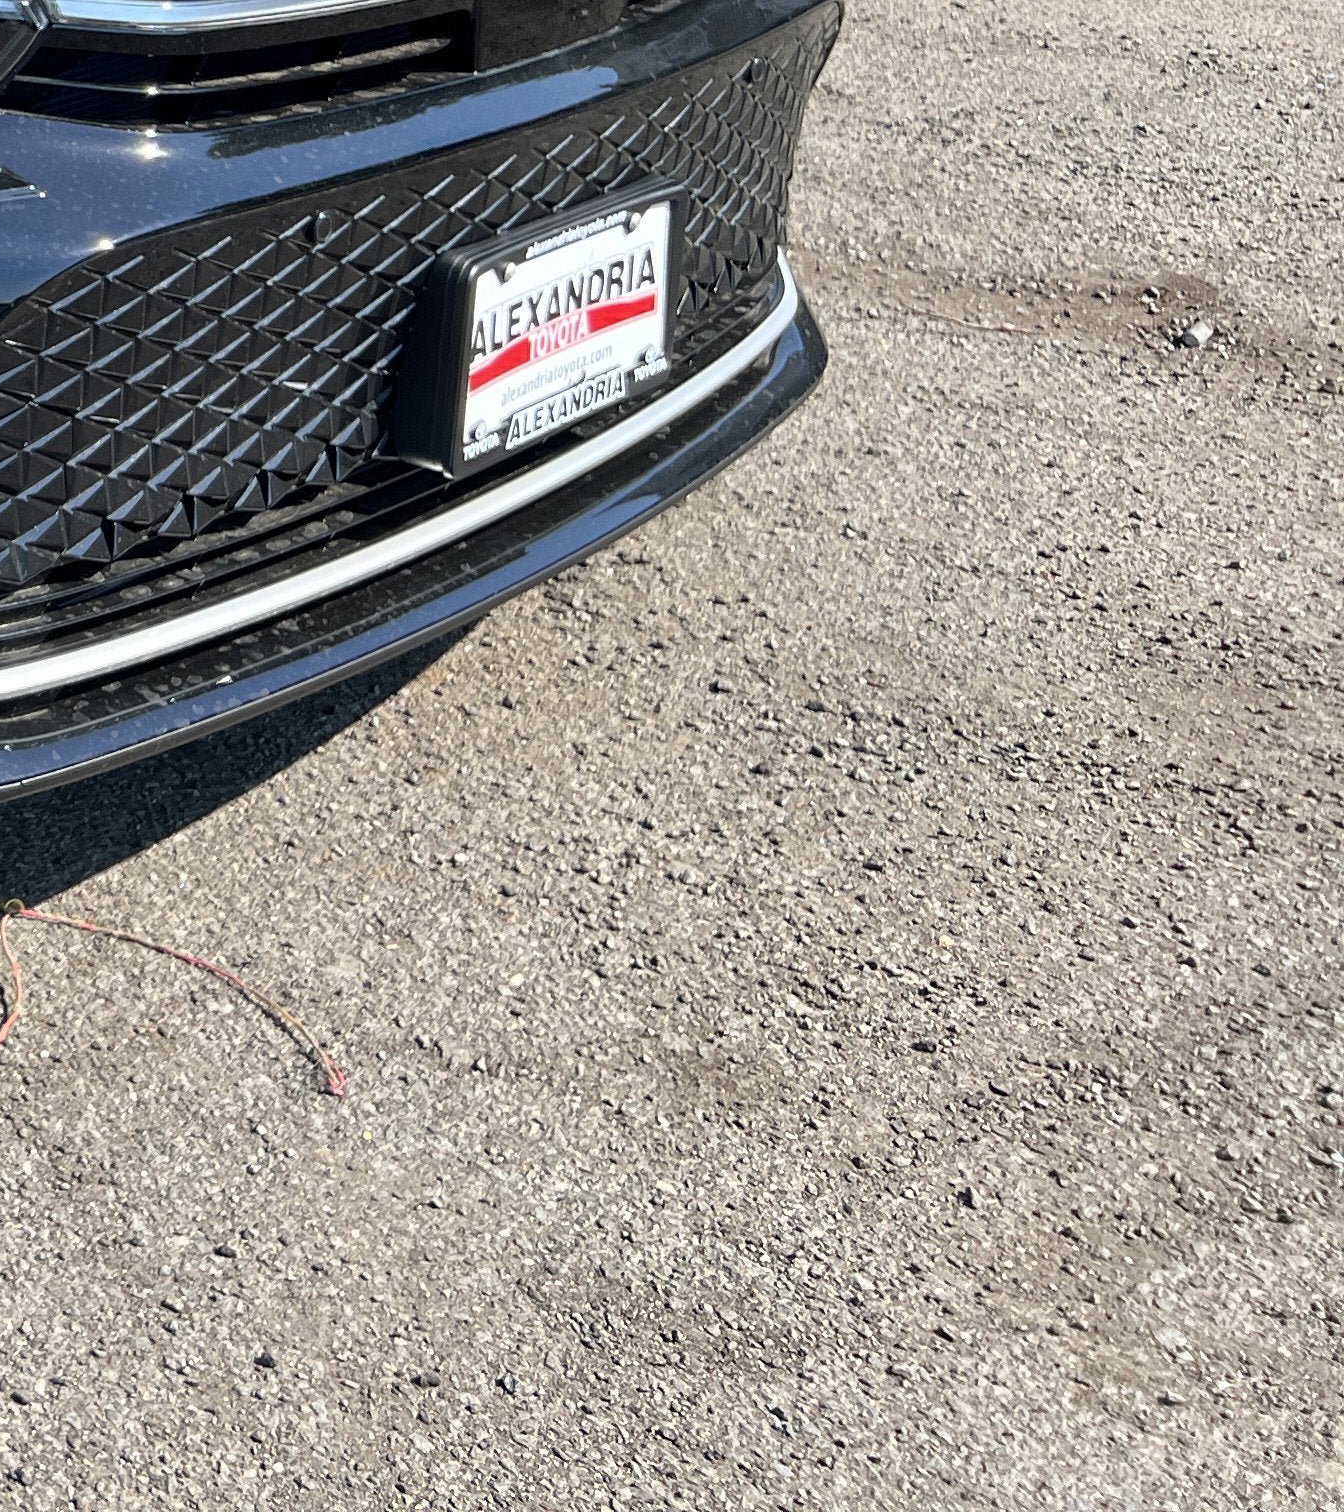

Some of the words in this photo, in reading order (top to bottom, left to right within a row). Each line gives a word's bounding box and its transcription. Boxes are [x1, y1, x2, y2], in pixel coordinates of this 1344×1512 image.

[470, 248, 656, 361] ALEXANDRIA
[529, 311, 590, 361] TOYOTA
[501, 343, 613, 407] alexandriatoyota.com
[633, 356, 668, 383] TOYOTA
[509, 371, 624, 442] ALEXANDRIA
[463, 431, 500, 462] TOYOTA
